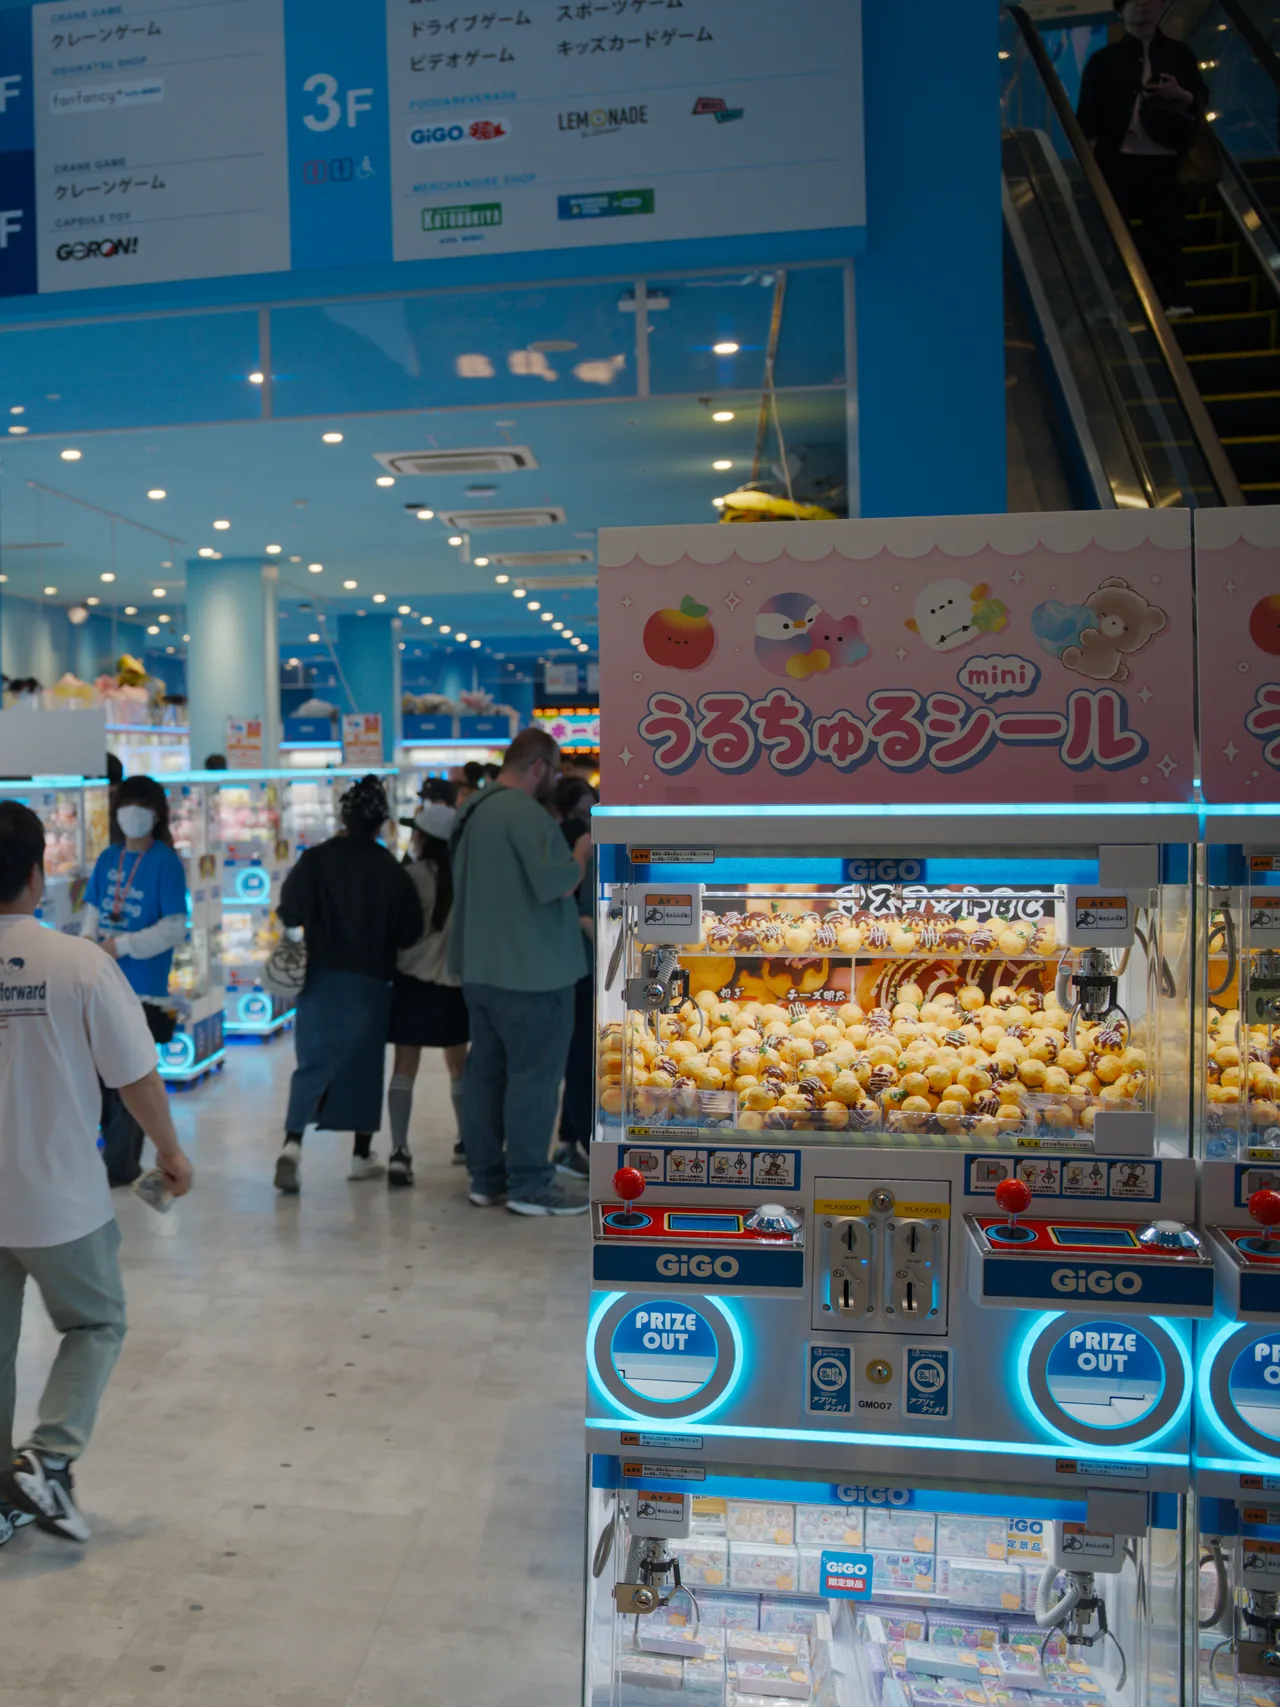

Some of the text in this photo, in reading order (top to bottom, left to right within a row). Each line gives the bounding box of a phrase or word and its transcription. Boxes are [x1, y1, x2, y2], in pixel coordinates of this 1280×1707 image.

[411, 10, 532, 38] ドライブゲーム
[51, 21, 162, 50] クレーンゲーム
[557, 26, 714, 56] キッズカードゲーム
[410, 47, 516, 72] ビデオゲーム
[302, 73, 374, 132] 3F
[558, 104, 649, 131] LEMONADE
[410, 125, 465, 145] GiGO
[53, 157, 126, 174] CRANE GAME
[55, 174, 167, 201] クレーンゲーム
[55, 212, 131, 228] CAPSULE TOY
[56, 236, 139, 262] GORON!
[967, 663, 1028, 687] mini
[641, 689, 1145, 771] うるちゅるシール
[848, 858, 922, 881] GiGO
[0, 981, 47, 1002] forward
[655, 1253, 740, 1279] GiGO
[1051, 1269, 1143, 1295] GiGO
[635, 1310, 697, 1332] PRIZE
[642, 1331, 689, 1352] OUT
[1068, 1330, 1137, 1354] PRIZE
[1077, 1353, 1128, 1374] OUT
[812, 1396, 837, 1404] アプリで
[823, 1404, 847, 1412] タッチ!
[858, 1400, 893, 1410] GM007
[909, 1397, 935, 1406] アプリで
[921, 1406, 945, 1414] タッチ!
[837, 1482, 910, 1505] GiGO
[1009, 1518, 1043, 1535] iGO
[1007, 1539, 1041, 1552] 定景品
[826, 1561, 867, 1576] GiGO
[828, 1577, 863, 1588] 限定景品
